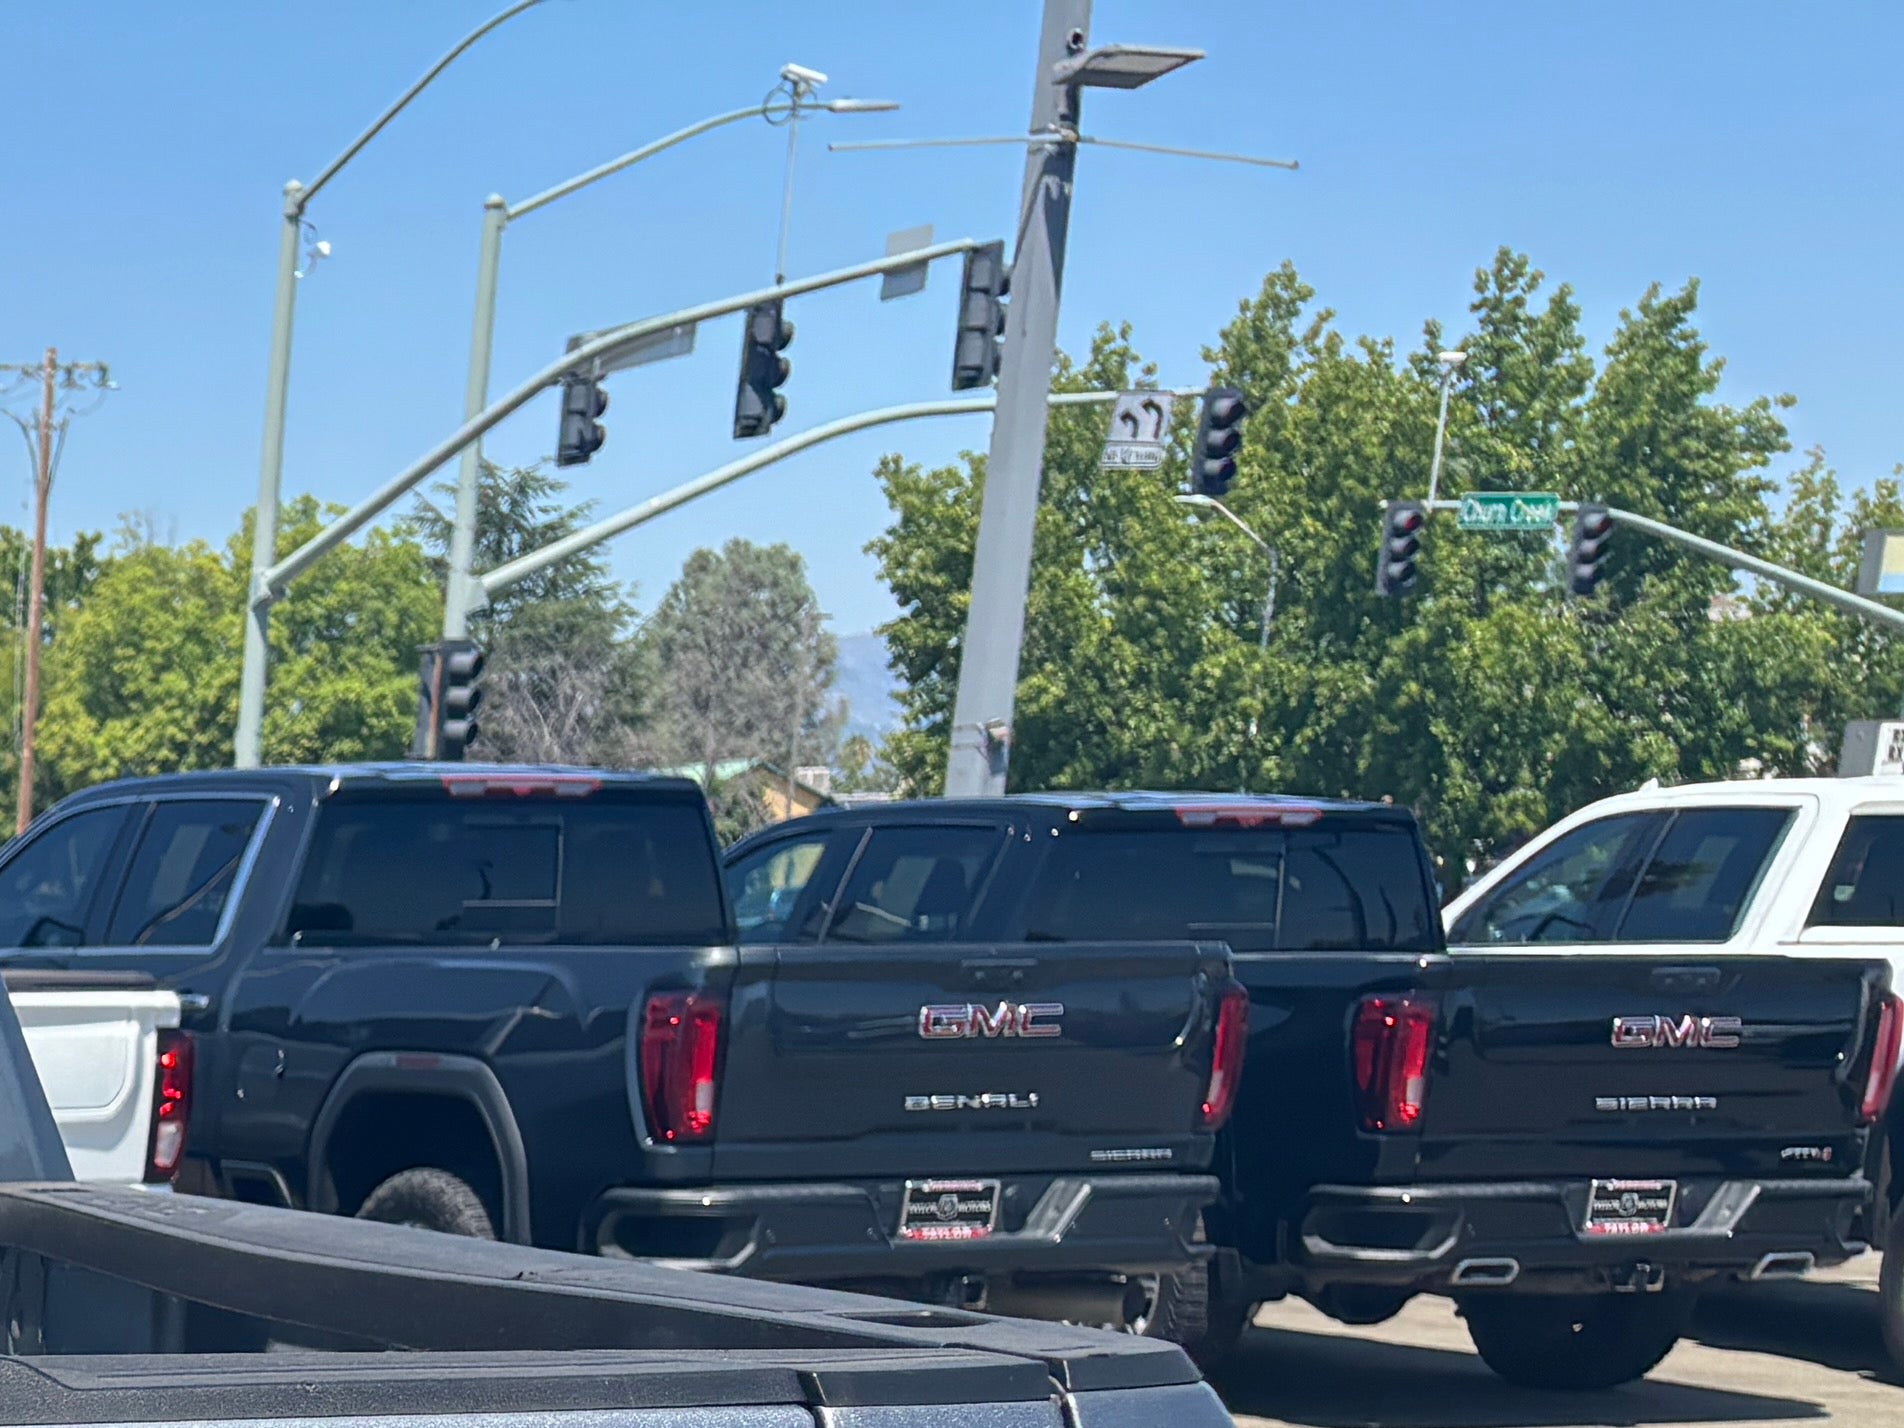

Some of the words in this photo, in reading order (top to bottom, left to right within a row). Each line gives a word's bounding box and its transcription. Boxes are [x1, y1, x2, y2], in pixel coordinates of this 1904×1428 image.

[919, 1001, 1064, 1039] GMC
[1611, 1014, 1742, 1048] GMC
[904, 1092, 1040, 1110] DENALI
[1595, 1096, 1717, 1111] SIERRA
